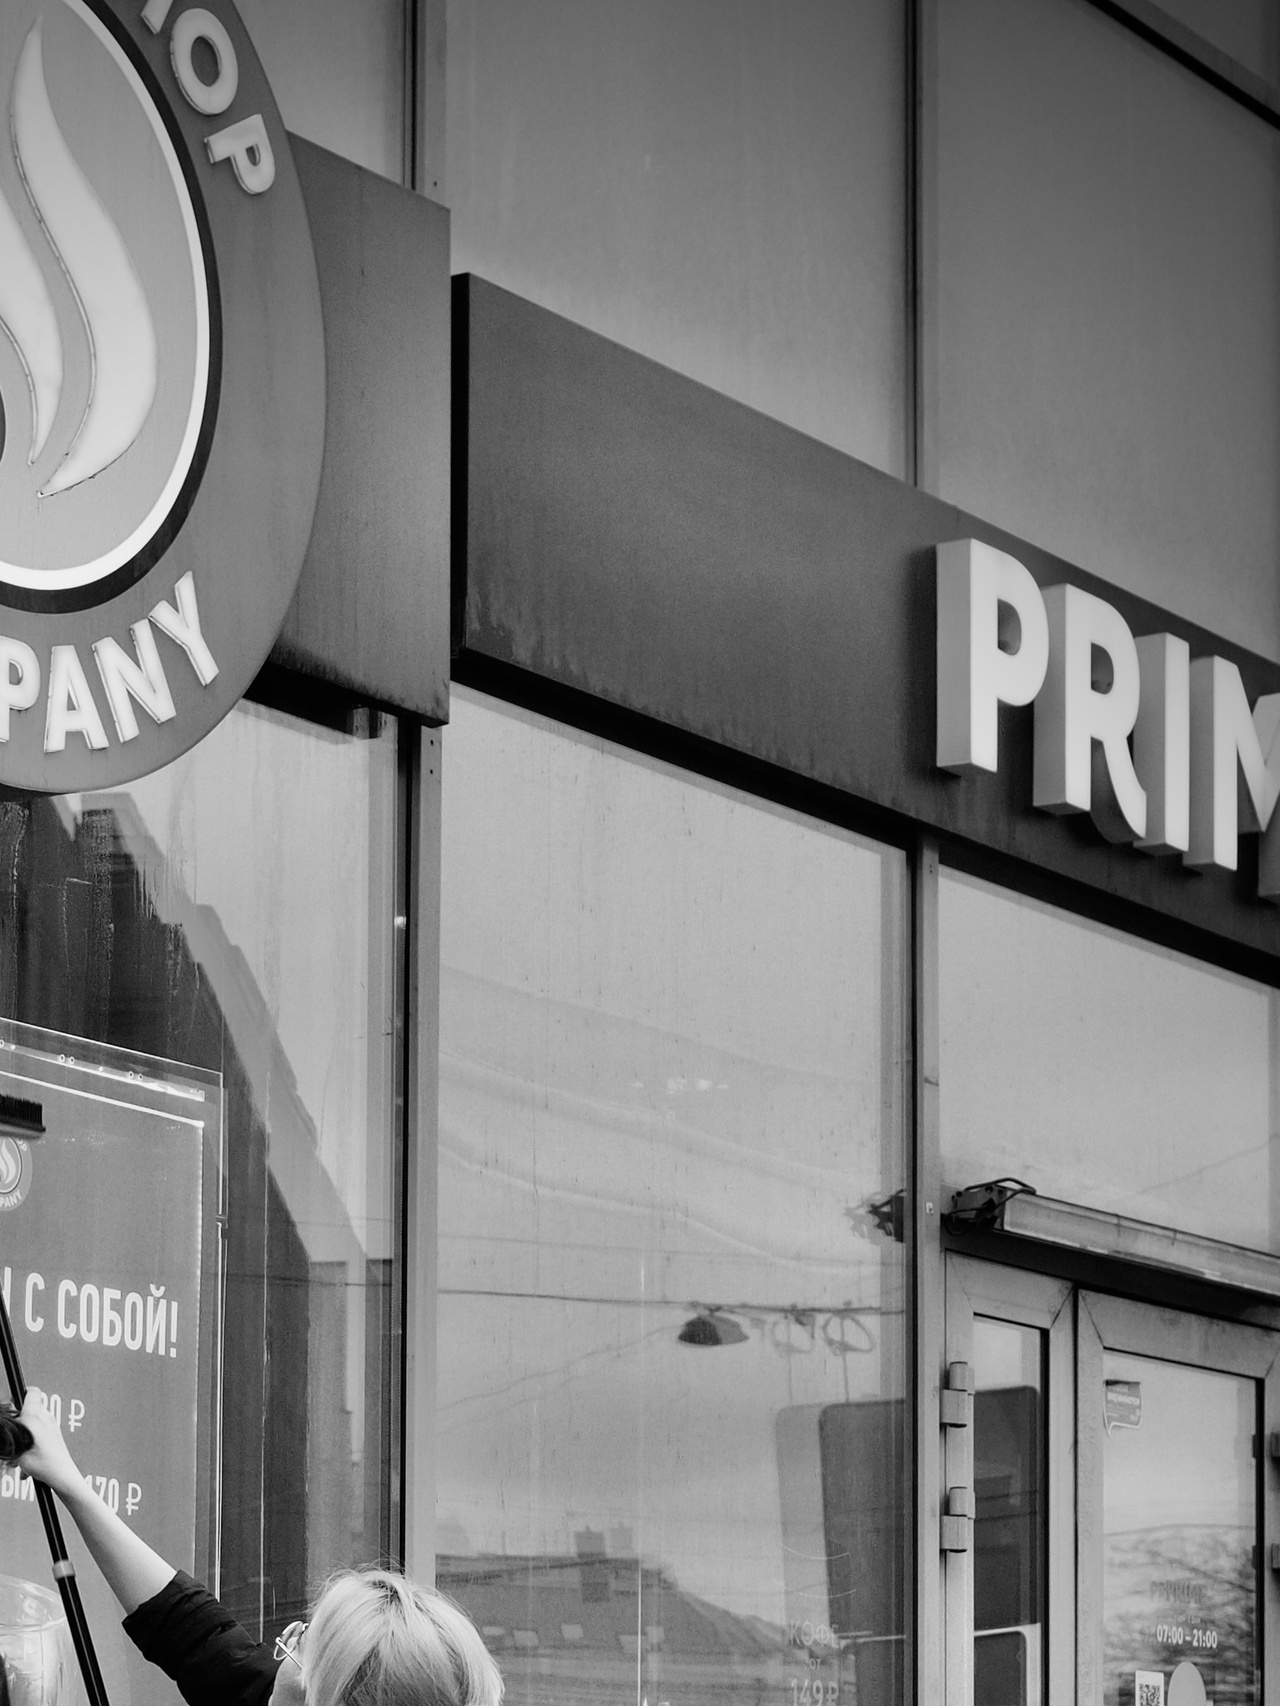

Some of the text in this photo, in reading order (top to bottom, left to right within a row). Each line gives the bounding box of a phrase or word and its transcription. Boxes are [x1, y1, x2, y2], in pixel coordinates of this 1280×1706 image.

[25, 1272, 45, 1333] С
[58, 1279, 178, 1358] СОБОЙ!
[1157, 1624, 1183, 1645] 07:00
[1193, 1628, 1218, 1649] 21:00
